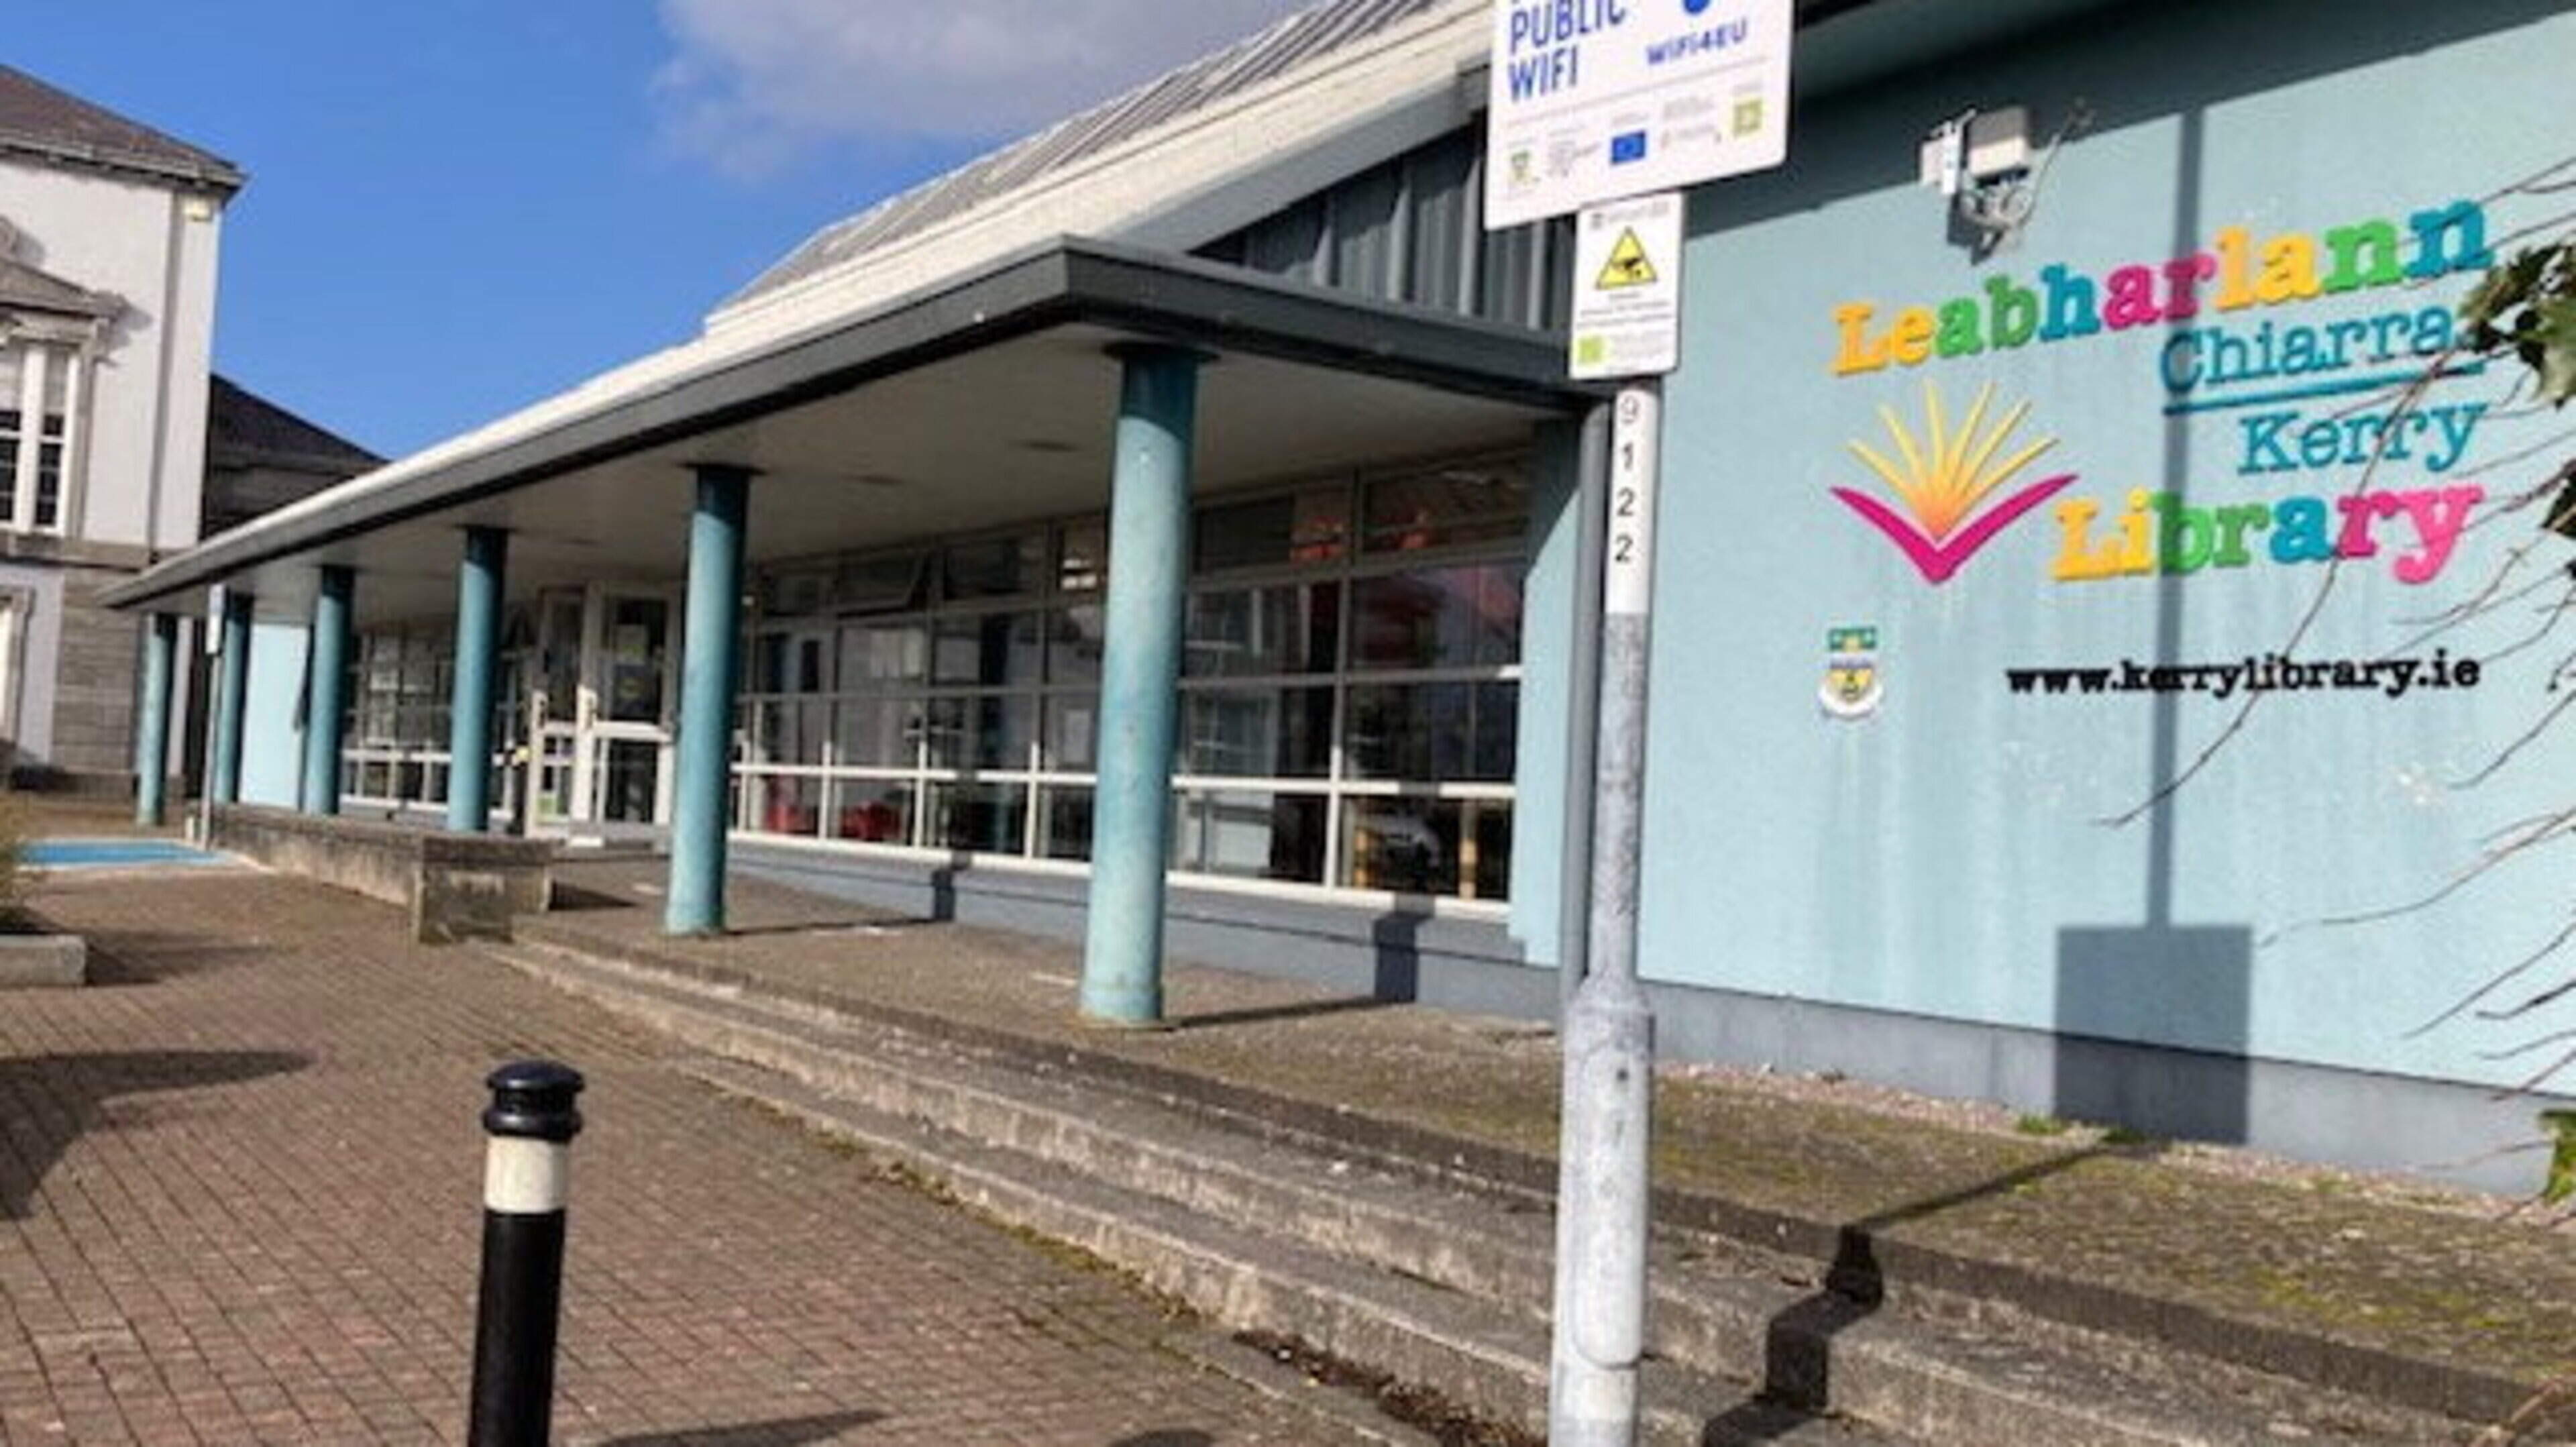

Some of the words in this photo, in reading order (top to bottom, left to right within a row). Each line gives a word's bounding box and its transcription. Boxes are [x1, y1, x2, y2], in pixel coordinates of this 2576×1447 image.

[1508, 46, 1577, 101] WIFI
[1831, 198, 2493, 376] Leabharlann
[2161, 303, 2485, 394] Chiarra
[2237, 403, 2487, 475] Kerry
[2051, 484, 2485, 585] Library
[2007, 648, 2480, 698] www.kerrylibrary.ie
